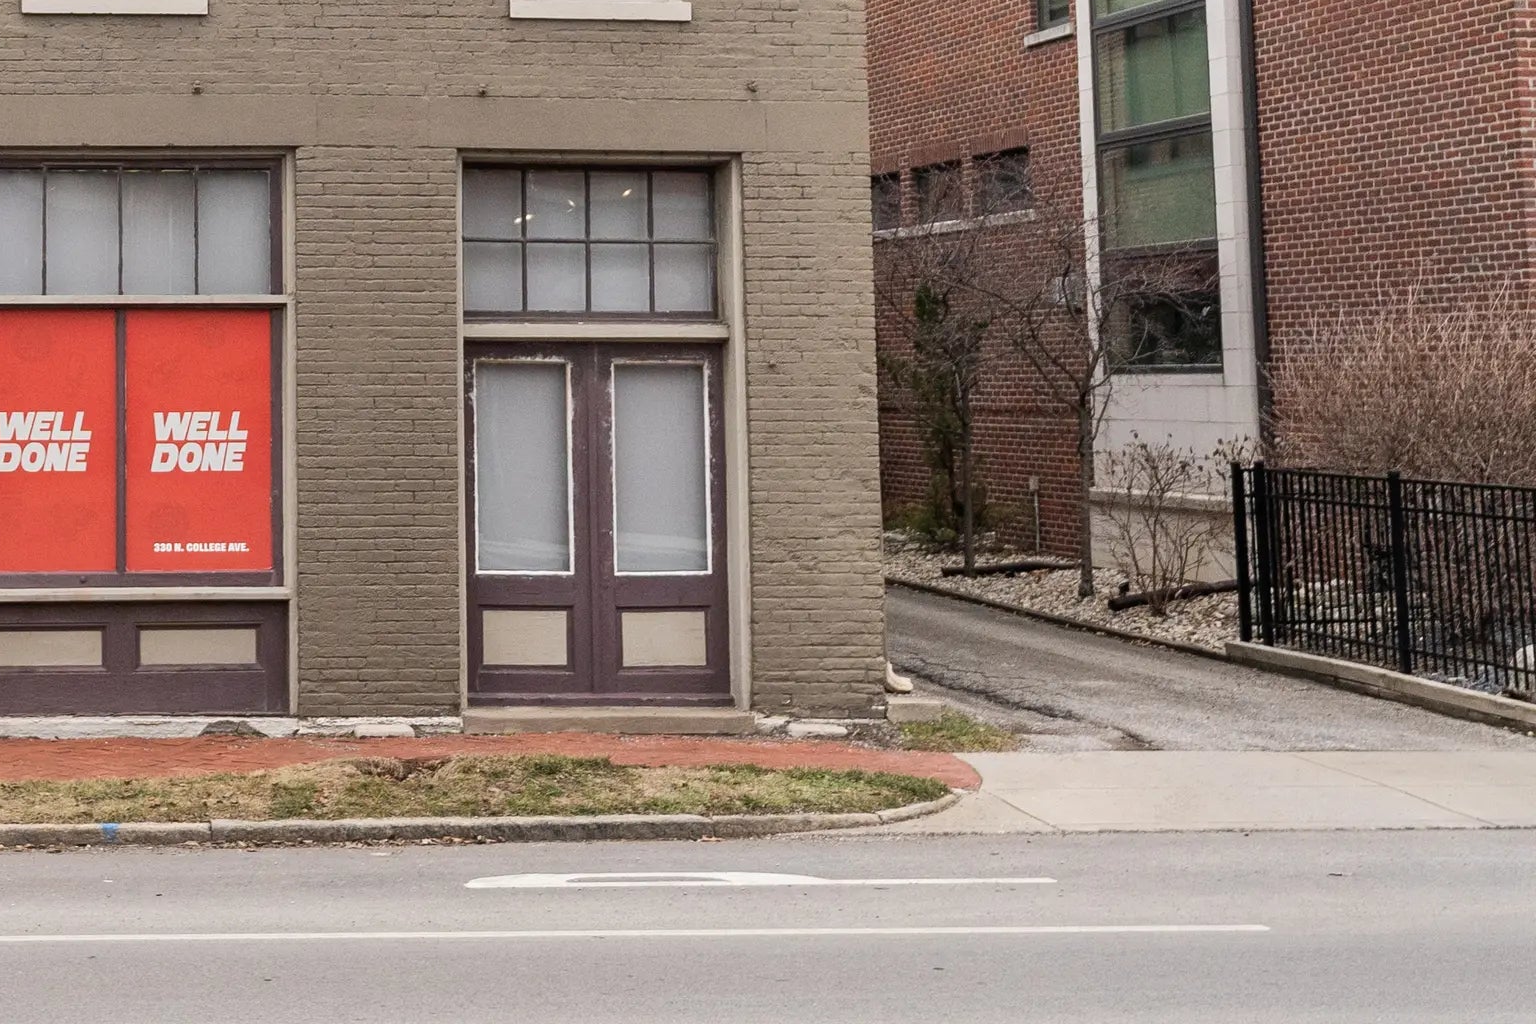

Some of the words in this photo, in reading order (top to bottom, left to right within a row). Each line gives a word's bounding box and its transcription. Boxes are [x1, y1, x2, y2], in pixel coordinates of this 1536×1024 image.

[153, 411, 248, 441] WELL
[151, 442, 246, 472] DONE
[153, 542, 172, 553] 330
[173, 542, 184, 553] N.
[186, 542, 226, 553] COLLEGE
[227, 542, 249, 553] AVE.
